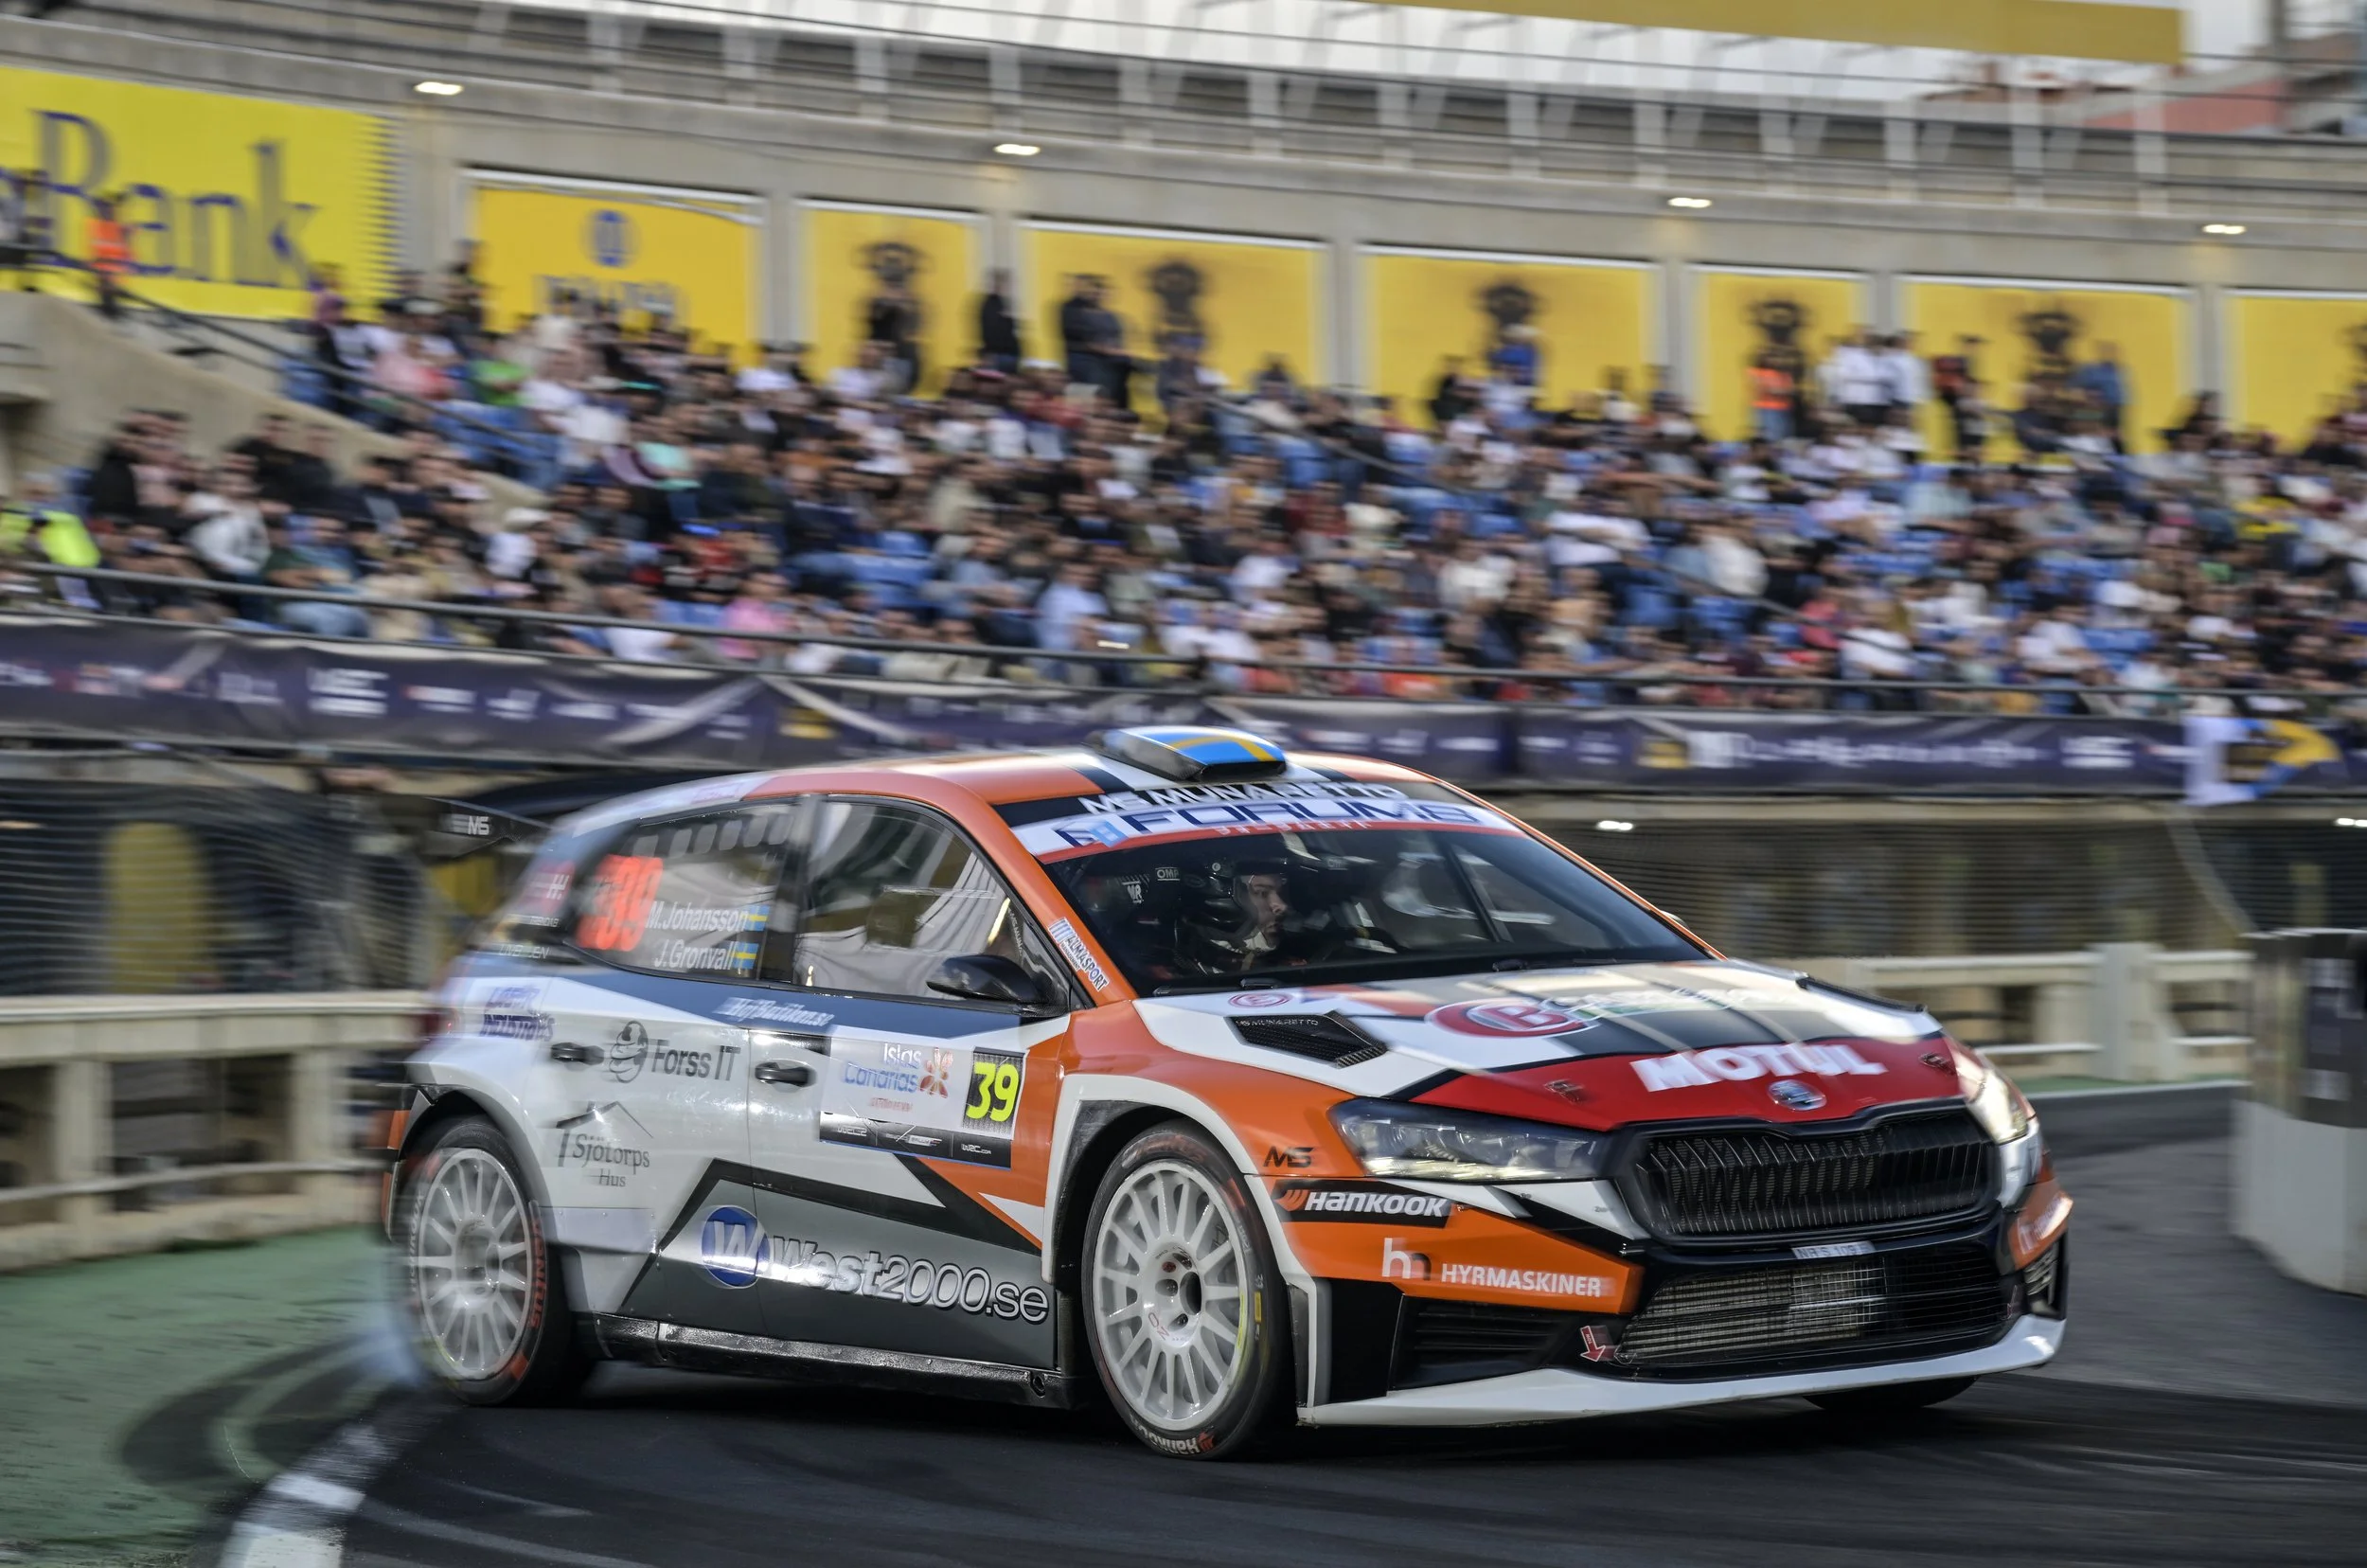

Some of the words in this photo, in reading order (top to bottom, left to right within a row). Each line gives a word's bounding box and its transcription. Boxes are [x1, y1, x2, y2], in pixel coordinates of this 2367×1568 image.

[1156, 868, 1180, 879] OMP
[575, 853, 664, 952] 39
[645, 901, 749, 932] M.Johansson
[1067, 935, 1108, 989] ALMASPORT
[650, 1040, 712, 1078] Forss
[714, 1044, 741, 1081] IT
[883, 1042, 923, 1067] Islas
[1629, 1042, 1889, 1093] MOTUL
[966, 1060, 1020, 1123] 39
[598, 1167, 627, 1187] Hus
[771, 1235, 1050, 1324] West2000.se
[1441, 1263, 1602, 1298] HYRMASKINER
